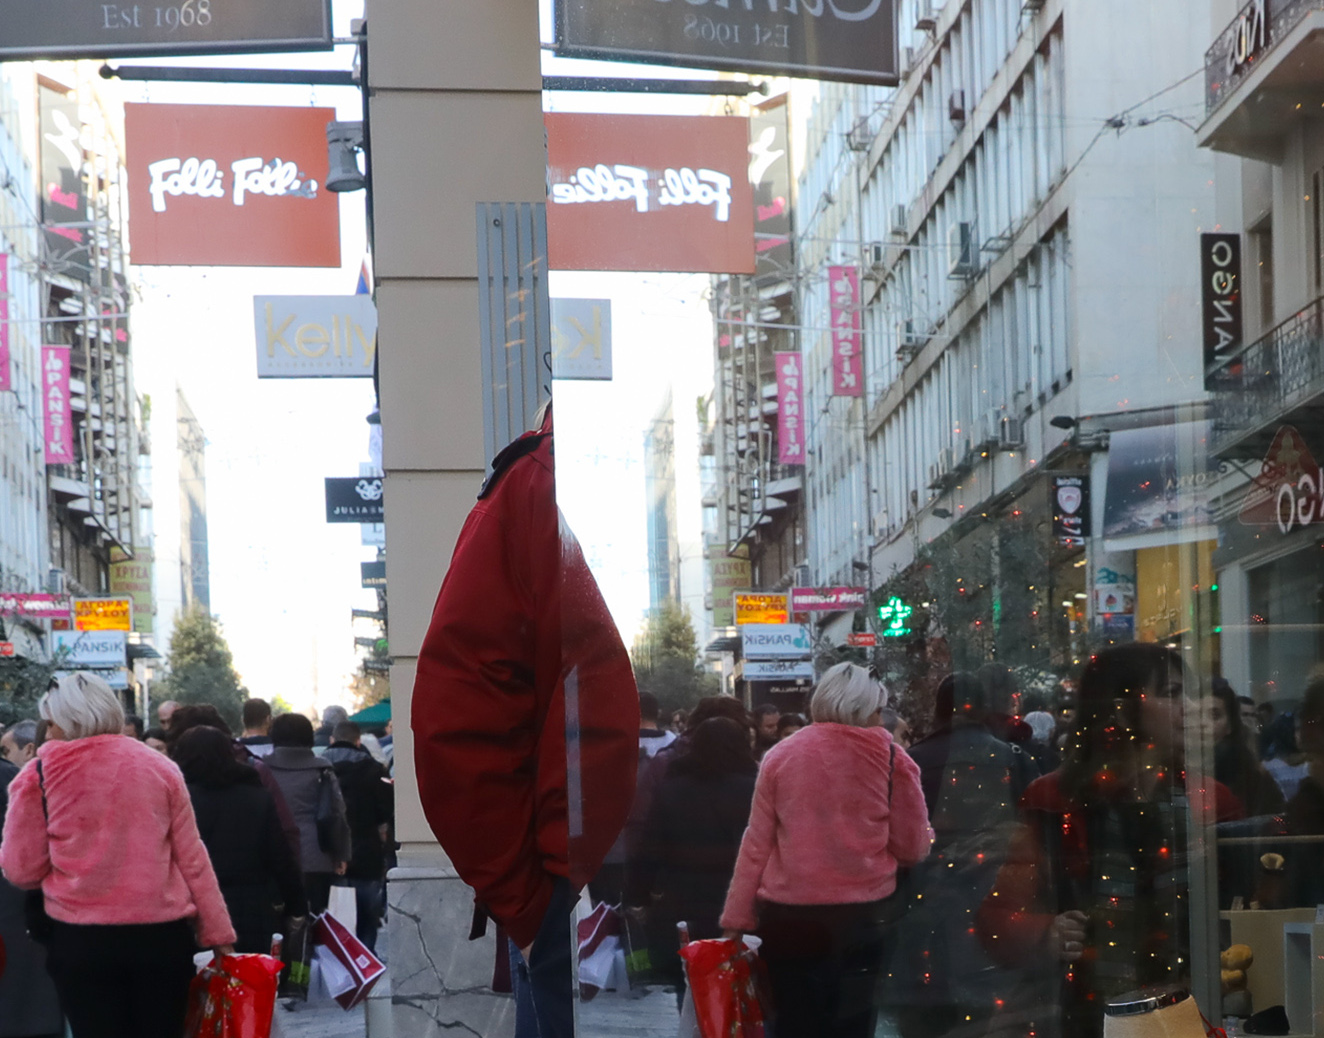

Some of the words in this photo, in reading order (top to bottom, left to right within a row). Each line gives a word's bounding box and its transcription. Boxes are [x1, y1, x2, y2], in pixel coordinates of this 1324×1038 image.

[101, 4, 140, 29] Est
[154, 0, 212, 33] 1968
[148, 157, 225, 212] Folli
[265, 302, 378, 367] Kelly
